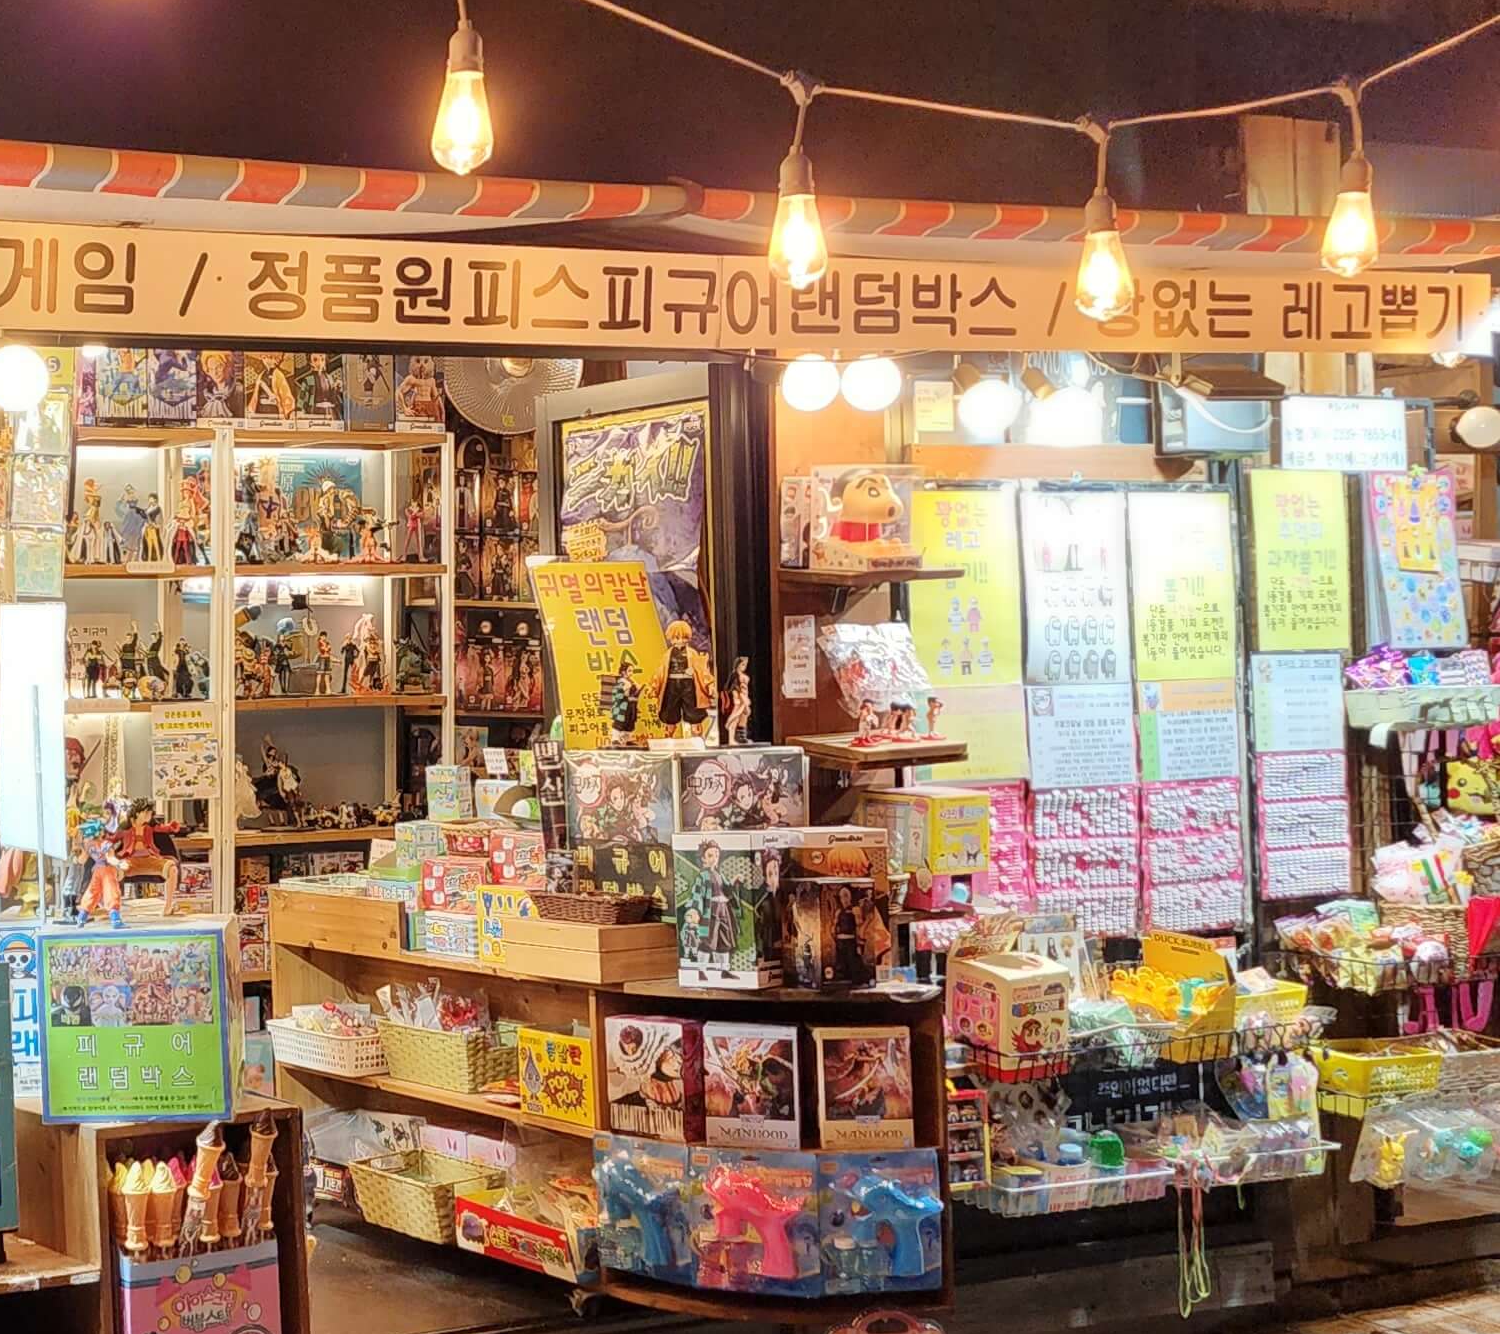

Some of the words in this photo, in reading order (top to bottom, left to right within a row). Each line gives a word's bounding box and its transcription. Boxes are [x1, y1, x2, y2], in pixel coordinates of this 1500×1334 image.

[1282, 279, 1464, 343] 레고뽑기
[945, 531, 981, 552] 레고
[537, 571, 651, 603] 귀멸의칼날
[574, 607, 634, 647] 랜덤
[1153, 933, 1180, 946] DUCK
[1181, 937, 1213, 953] BUBBLE
[547, 1075, 570, 1090] POP
[556, 1089, 579, 1107] POP
[719, 1125, 789, 1142] MANHOOD
[834, 1127, 903, 1142] MANHOOD
